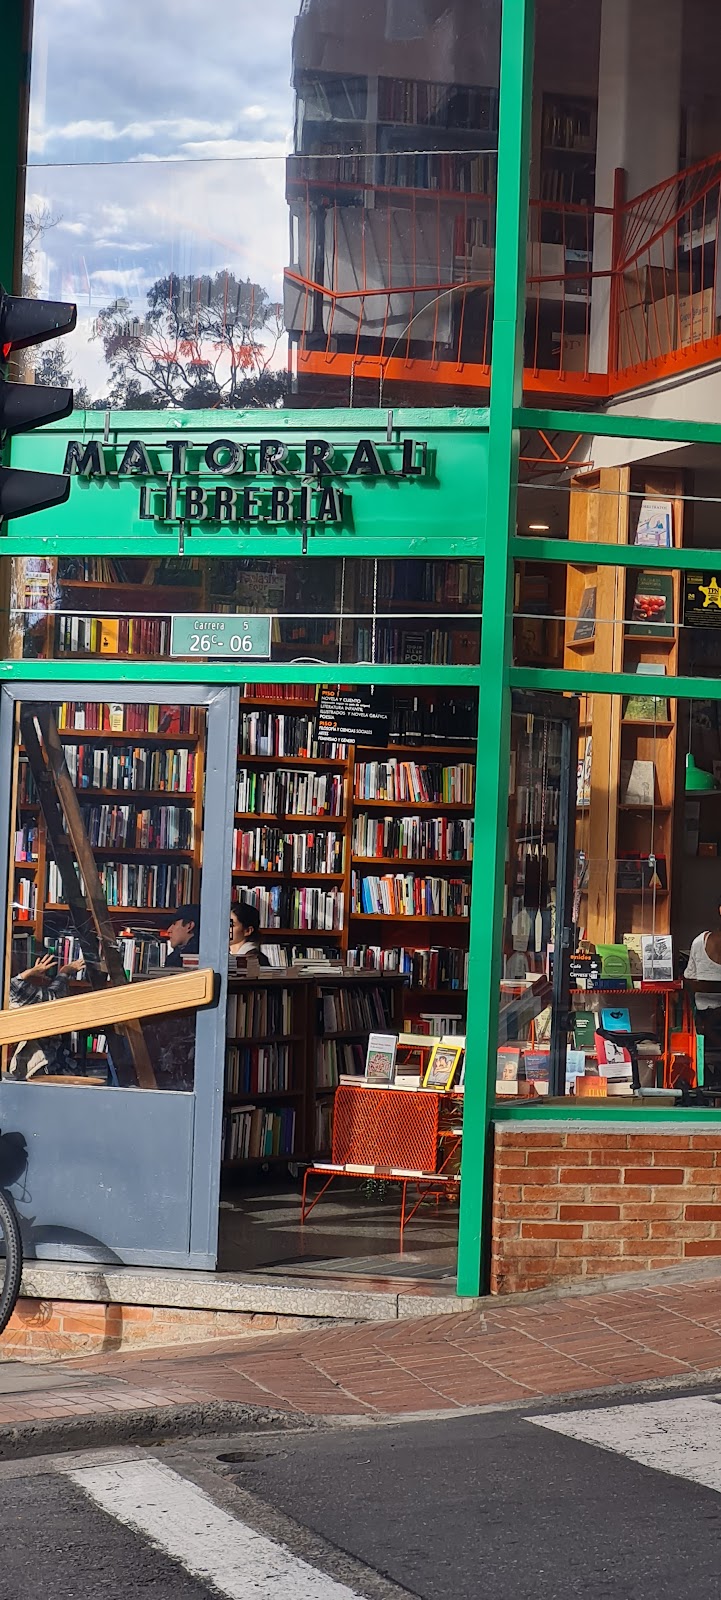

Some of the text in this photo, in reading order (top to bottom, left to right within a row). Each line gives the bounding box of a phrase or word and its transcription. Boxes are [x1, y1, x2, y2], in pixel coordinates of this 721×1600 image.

[63, 438, 426, 476] MATORRAL
[194, 620, 249, 631] Carrera 5
[230, 635, 253, 652] 06
[405, 654, 423, 662] POE
